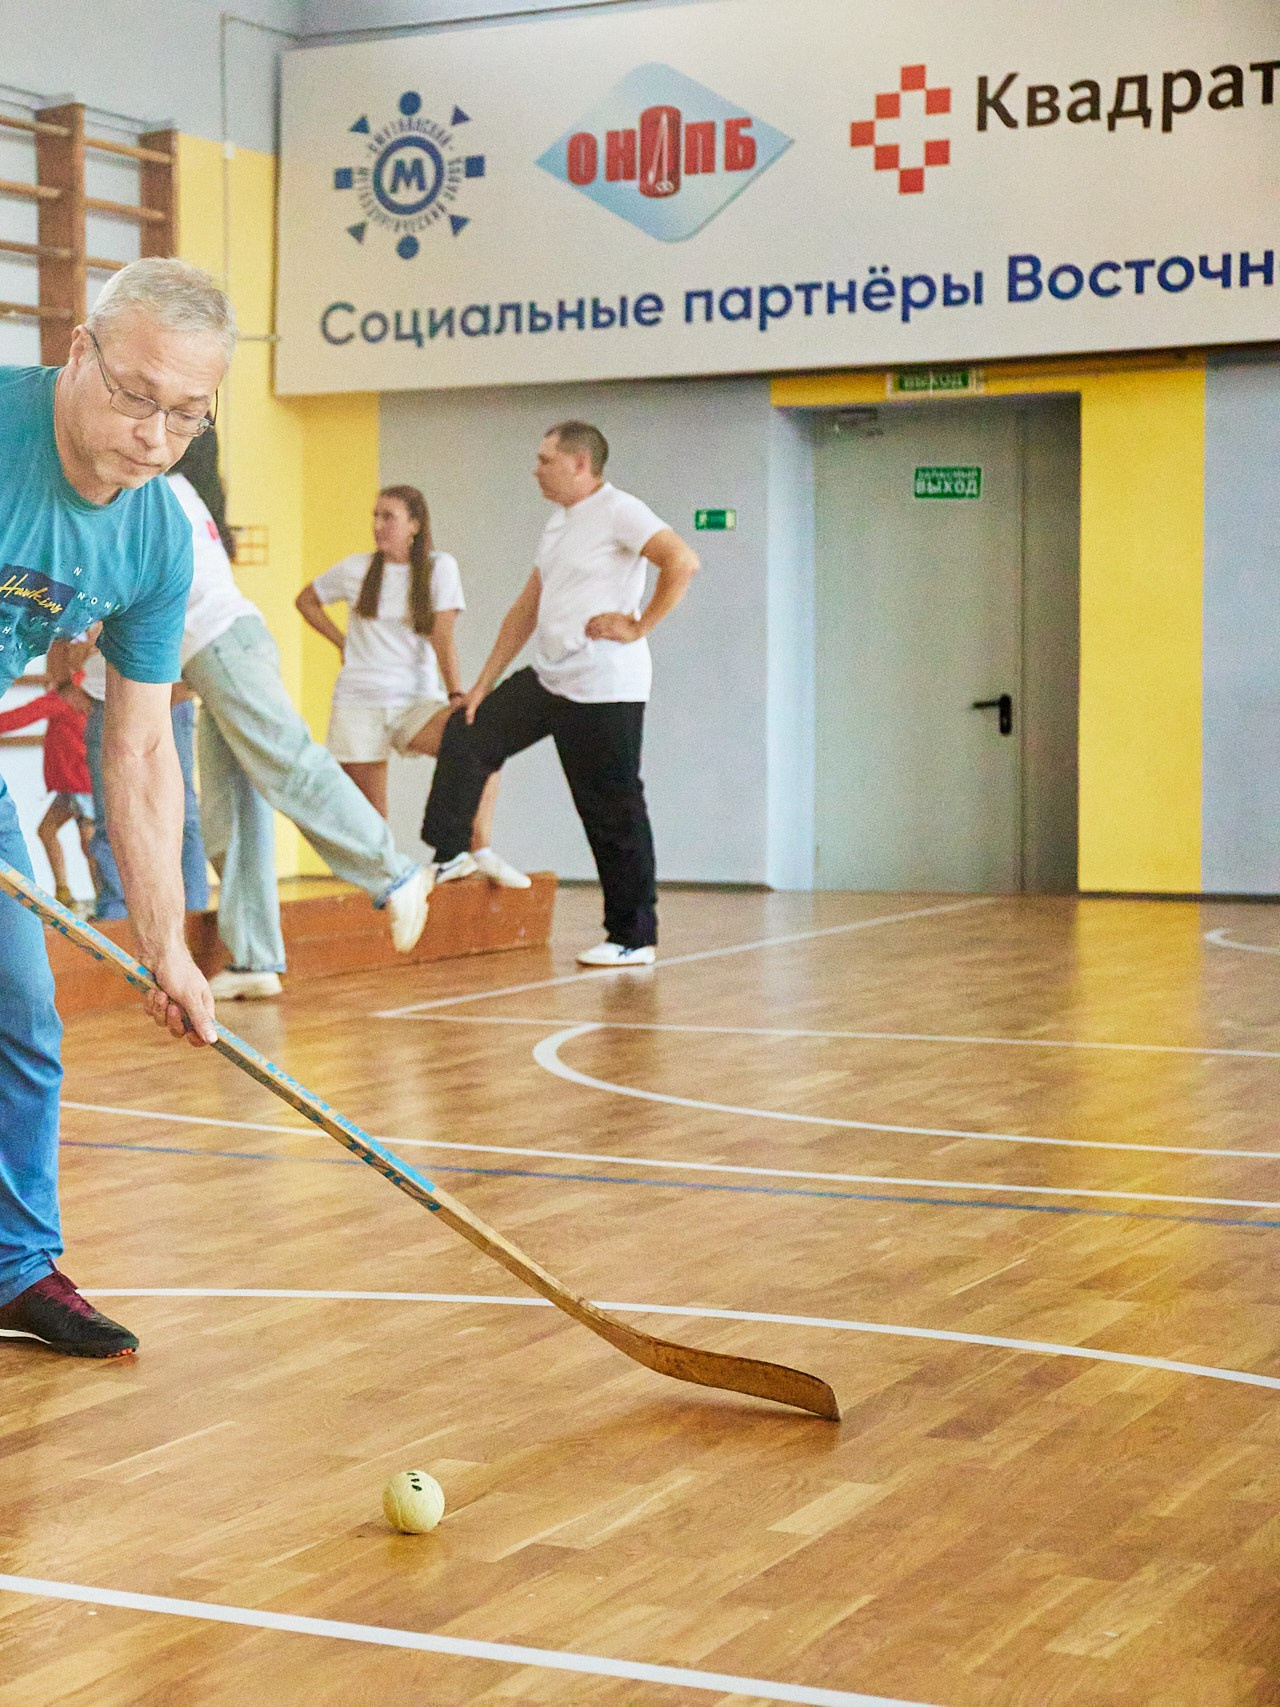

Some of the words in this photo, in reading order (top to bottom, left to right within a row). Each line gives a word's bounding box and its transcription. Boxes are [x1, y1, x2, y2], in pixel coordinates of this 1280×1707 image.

[976, 60, 1280, 133] Квадрат
[319, 292, 664, 349] Социальные
[684, 265, 983, 332] партнёры
[1007, 249, 1280, 303] Восточн
[916, 480, 977, 496] ВЫХОД
